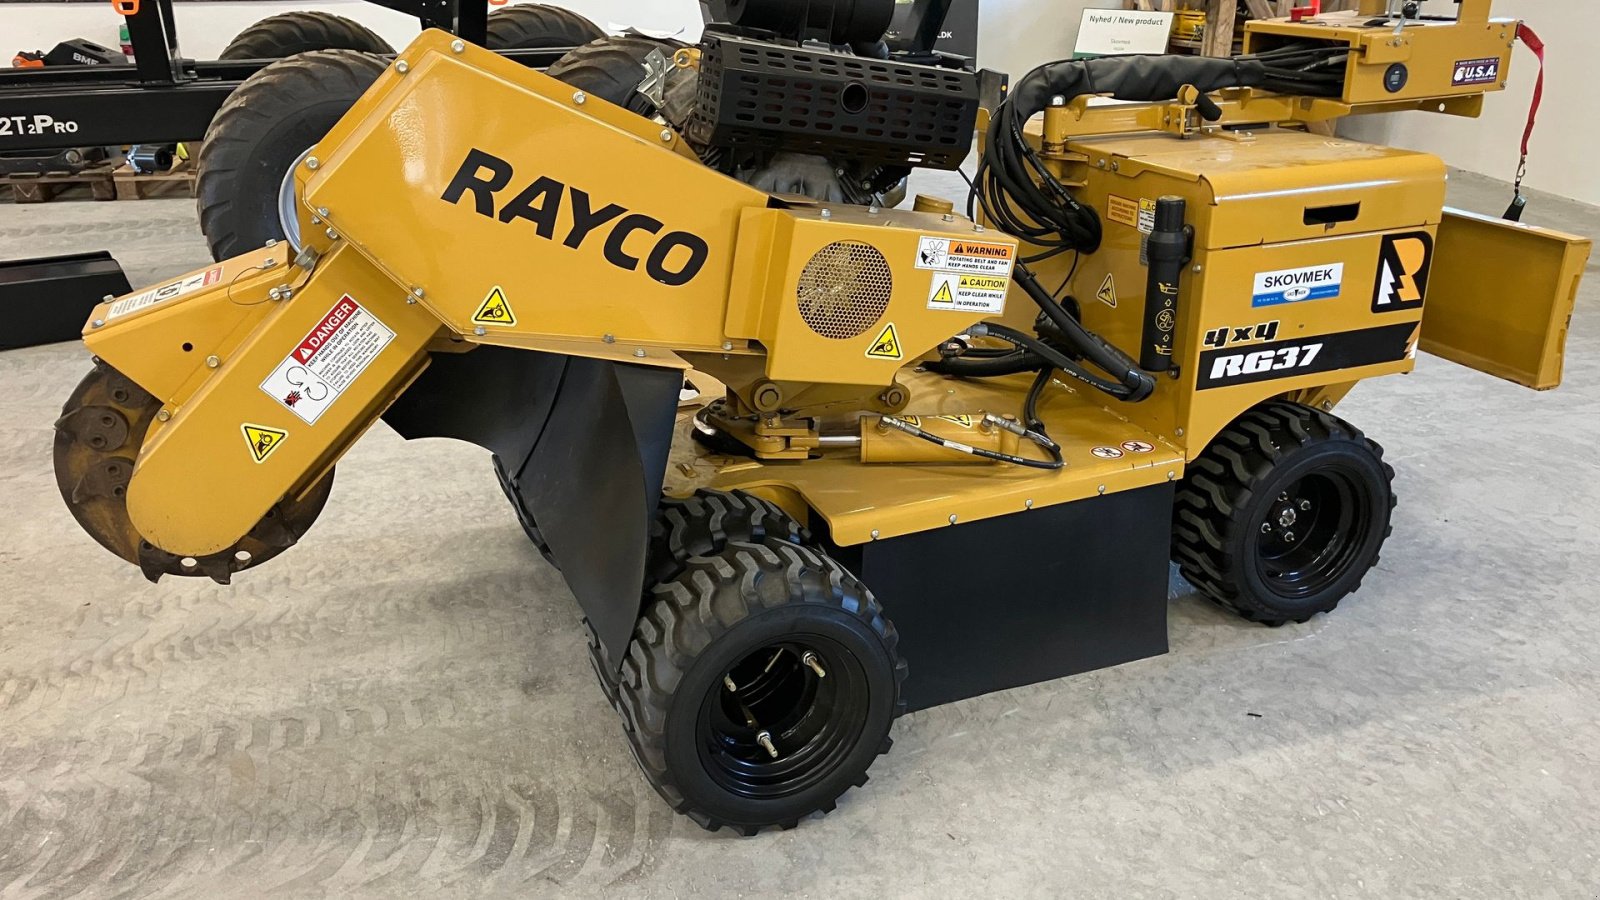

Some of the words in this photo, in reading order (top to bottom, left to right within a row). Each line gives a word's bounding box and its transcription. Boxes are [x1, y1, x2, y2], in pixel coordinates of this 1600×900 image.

[1090, 15, 1112, 24] Nyhed
[1119, 16, 1134, 24] New
[1135, 17, 1163, 26] product
[1465, 65, 1497, 79] U.S.A.
[440, 147, 709, 287] RAYCO
[965, 245, 1007, 257] WARNING
[969, 278, 1005, 288] CAUTION
[1263, 268, 1334, 289] SKOVMEK
[963, 300, 990, 308] OPERATION
[308, 302, 353, 348] DANGER
[1203, 320, 1280, 349] 4x4
[307, 355, 319, 367] KEEP
[317, 341, 332, 357] HANDS
[330, 333, 340, 343] OUT
[337, 326, 346, 334] OF
[343, 309, 362, 328] MACHINE
[320, 348, 334, 362] WHILE
[336, 321, 359, 345] OPERATION
[1209, 343, 1323, 380] RG37
